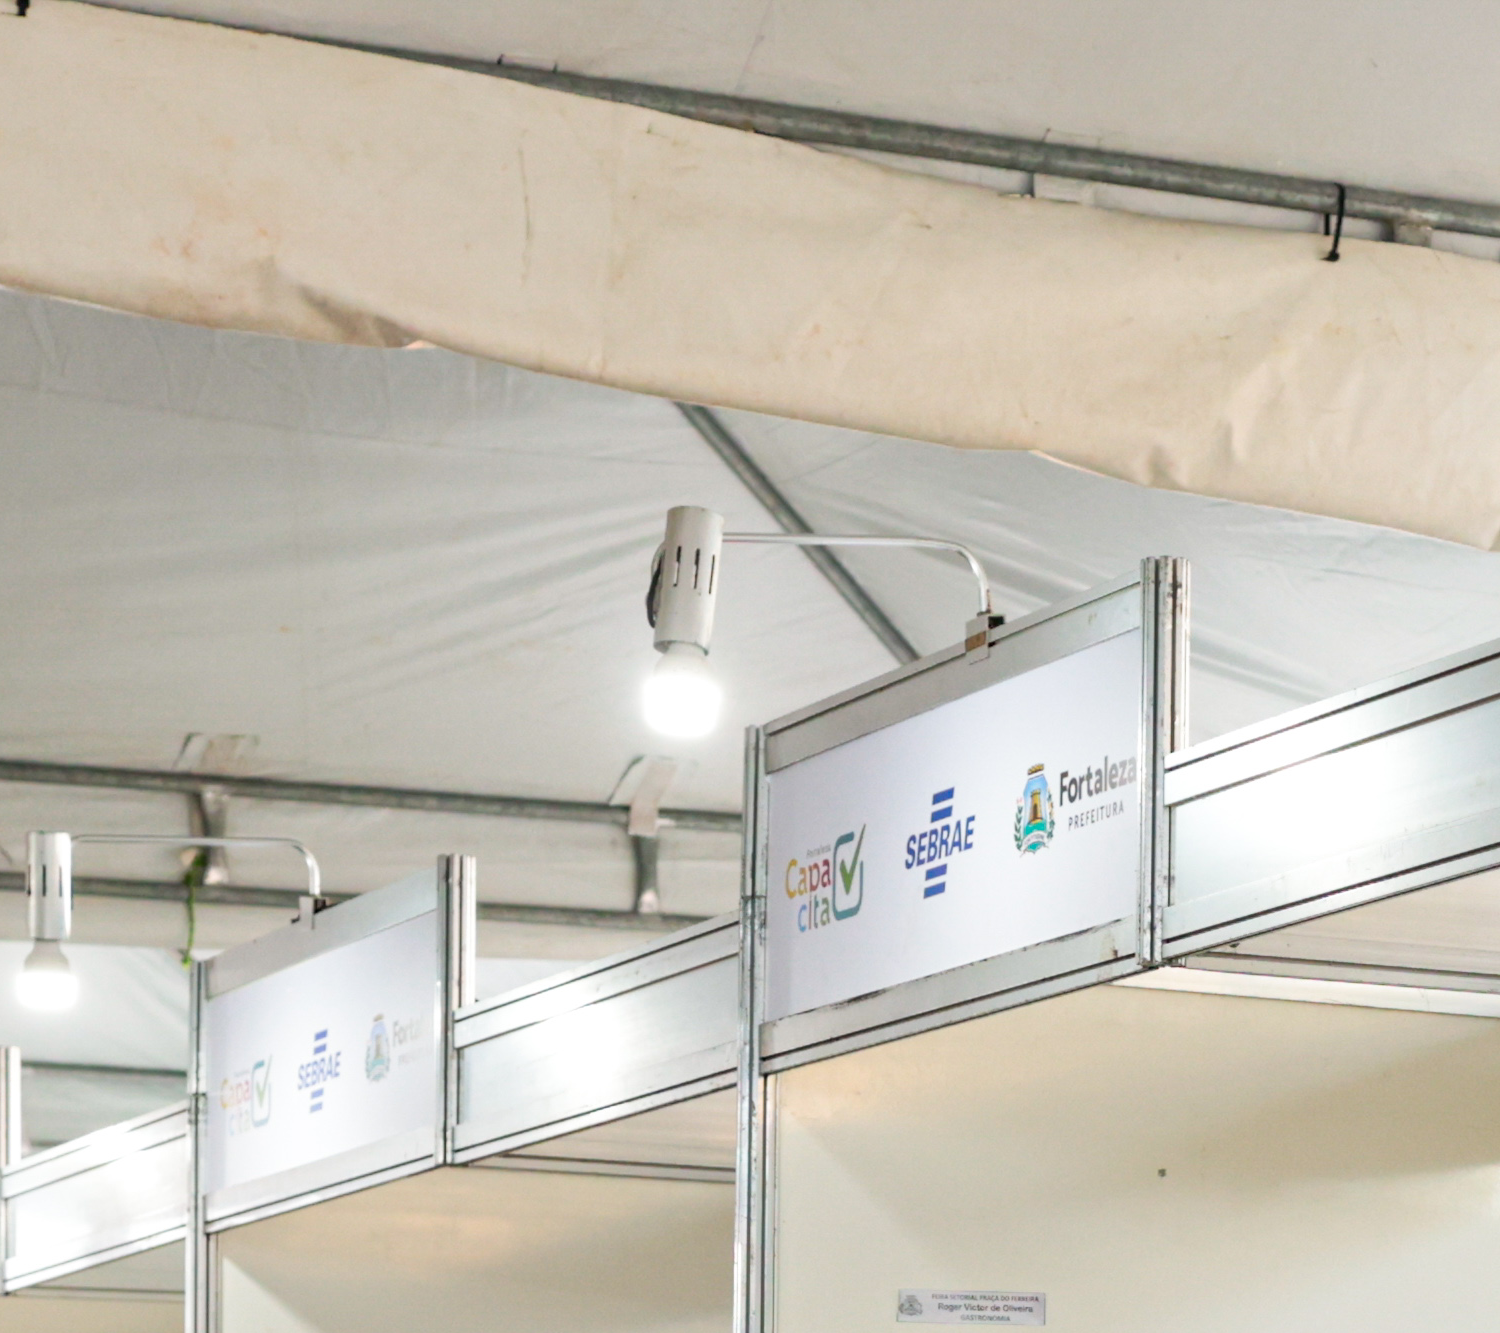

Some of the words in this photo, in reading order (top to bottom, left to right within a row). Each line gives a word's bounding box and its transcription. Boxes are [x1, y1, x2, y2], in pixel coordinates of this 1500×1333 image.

[1059, 756, 1137, 807] Fortaleza
[1068, 800, 1124, 831] PREFEITURA
[905, 815, 975, 870] SEBRAE
[785, 859, 832, 899] Capa
[798, 892, 830, 933] cita
[297, 1051, 341, 1091] SEBRAE
[938, 1303, 961, 1313] Roger
[964, 1304, 988, 1312] Victor
[990, 1304, 1001, 1312] de
[1003, 1305, 1034, 1313] Oliveira
